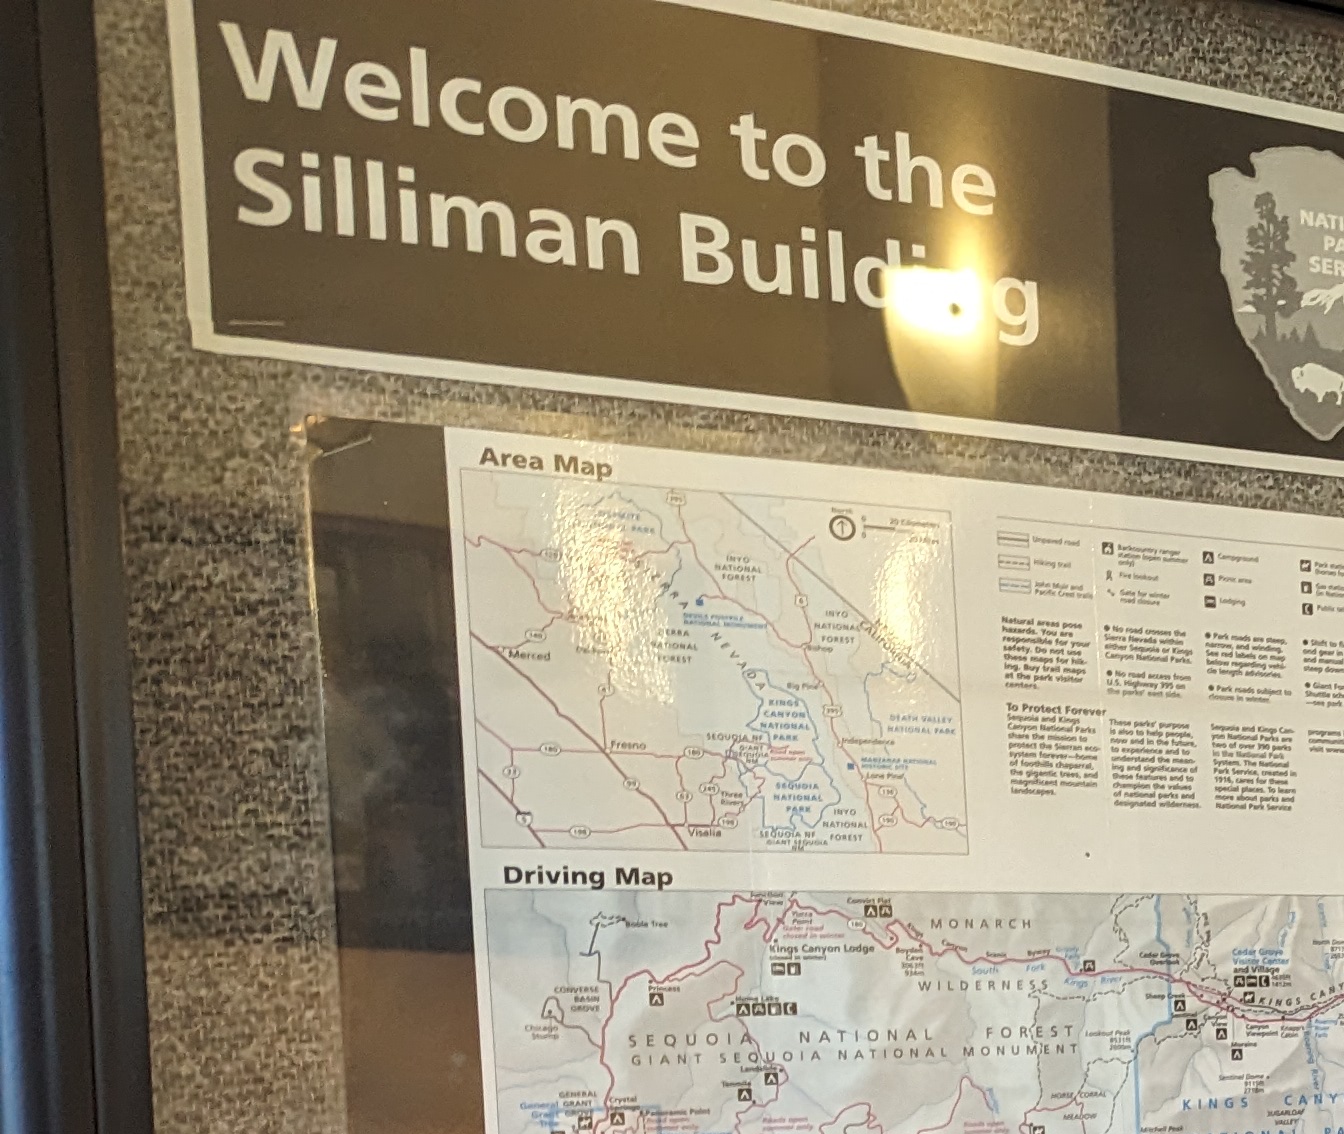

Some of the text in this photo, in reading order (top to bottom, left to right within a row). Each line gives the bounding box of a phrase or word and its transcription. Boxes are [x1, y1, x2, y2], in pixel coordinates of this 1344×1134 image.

[219, 20, 998, 216] Welcome to the
[233, 146, 1039, 346] Silliman Buildg
[479, 447, 613, 480] Area Map
[508, 650, 551, 662] Merced
[1007, 702, 1106, 716] To Protect Forever
[610, 741, 647, 752] Fresno
[687, 827, 722, 839] Visalia
[503, 864, 673, 890] Driving Map
[930, 918, 1032, 930] MONARCH
[769, 943, 875, 956] Kings Canyon Lodge
[917, 980, 1049, 992] WILDERNESS
[629, 1025, 1074, 1048] SEQUOIA NATIONAL FOREST
[631, 1044, 1079, 1065] GIANT SEQUOIA NATIONAL MONUMENT
[1182, 1097, 1249, 1111] KINGS
